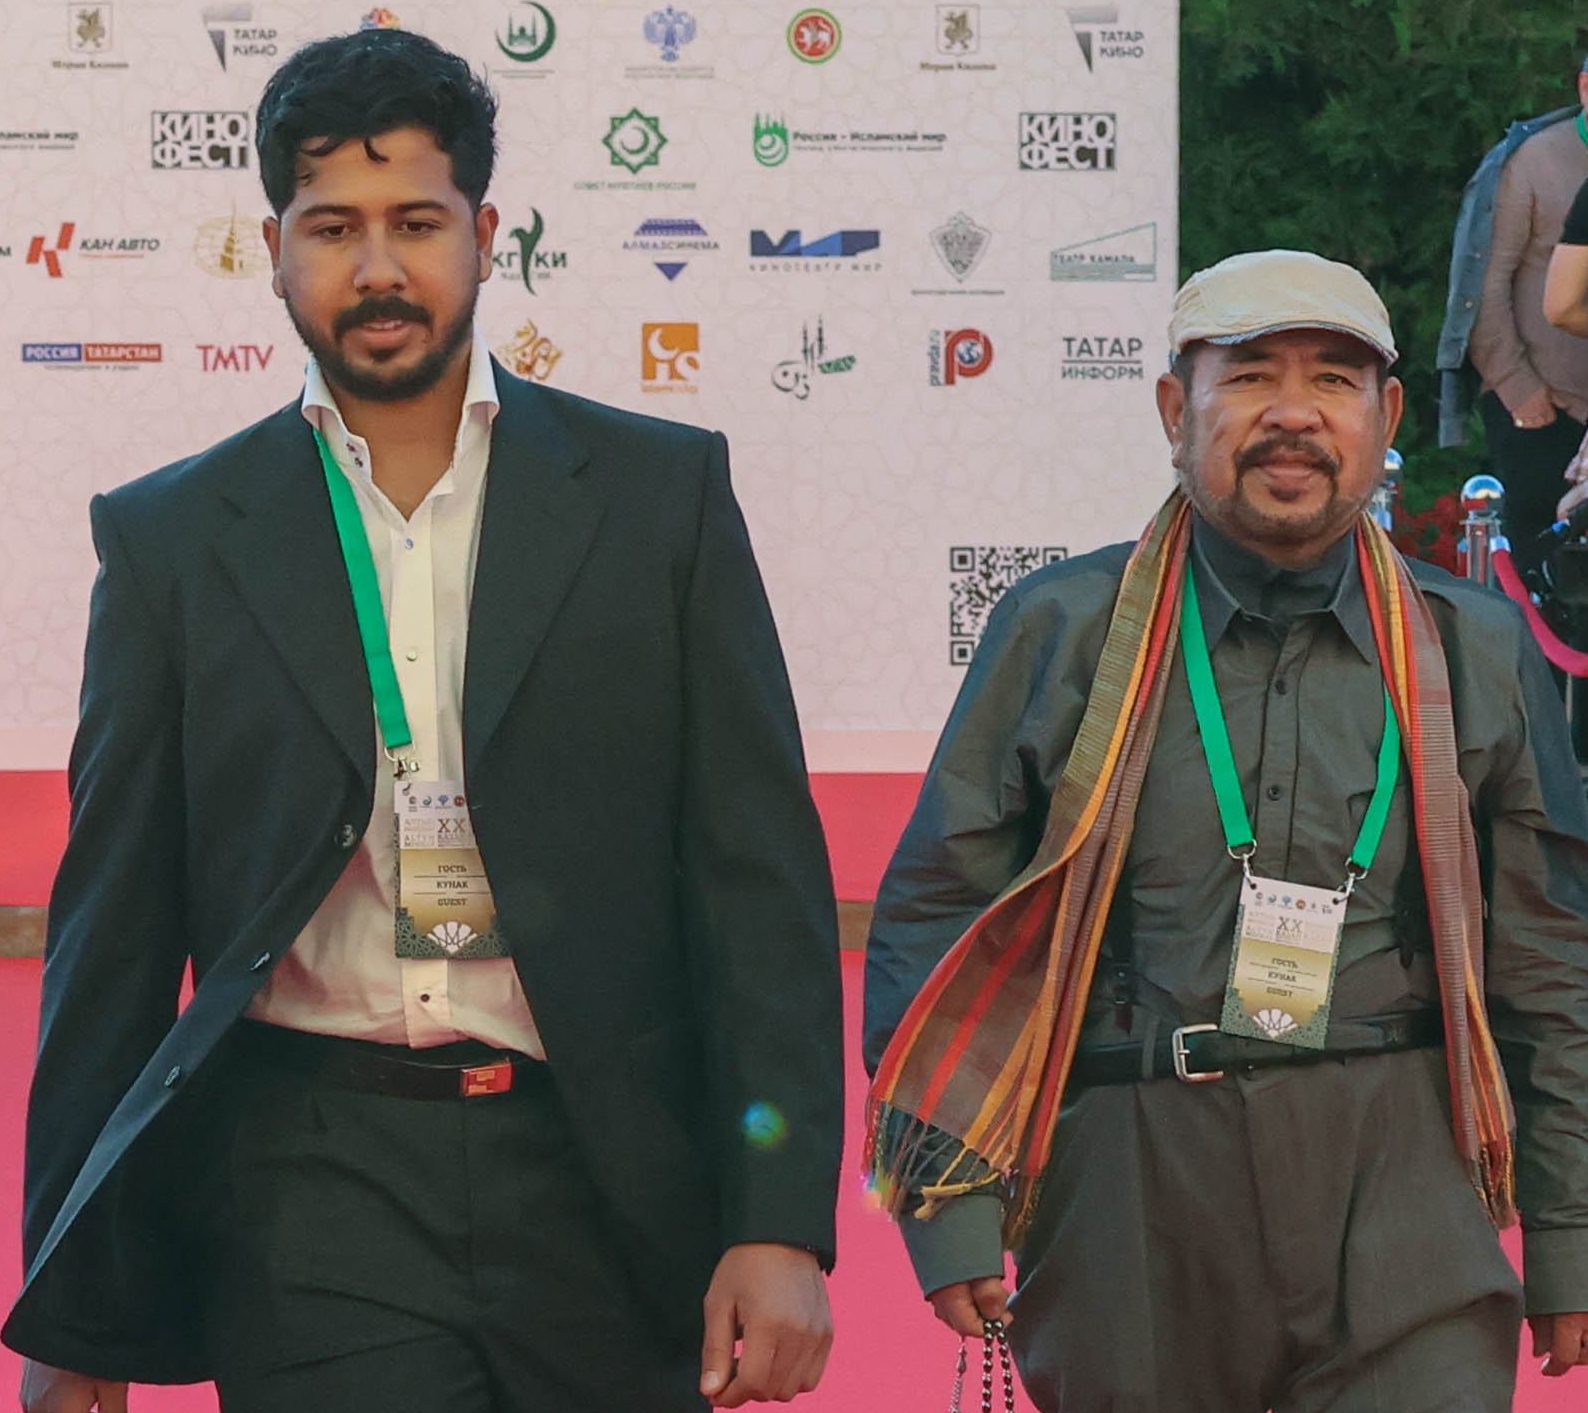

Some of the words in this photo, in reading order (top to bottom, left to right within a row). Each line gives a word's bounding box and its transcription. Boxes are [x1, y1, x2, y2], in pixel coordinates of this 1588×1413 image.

[233, 28, 278, 41] ТАТАР
[1099, 30, 1145, 43] ТАТАР
[233, 44, 278, 57] КИНО
[1099, 45, 1145, 59] КИНО
[151, 112, 249, 140] КИНО
[1020, 113, 1116, 141] КИНО
[152, 140, 248, 168] ФЕСТ
[1020, 141, 1115, 169] ФЕСТ
[79, 238, 115, 251] КАН
[116, 238, 161, 251] АВТО
[25, 346, 80, 360] РОССИЯ
[86, 346, 161, 361] ТАТАРСТАН
[1062, 337, 1143, 357] ТАТАР
[196, 344, 275, 373] TMTV
[1061, 365, 1144, 380] ИНФОРМ
[437, 864, 467, 874] ГОСТЬ
[436, 880, 469, 889] КУНАК
[437, 897, 468, 907] GUEST
[1271, 957, 1299, 969] ГОСТЬ
